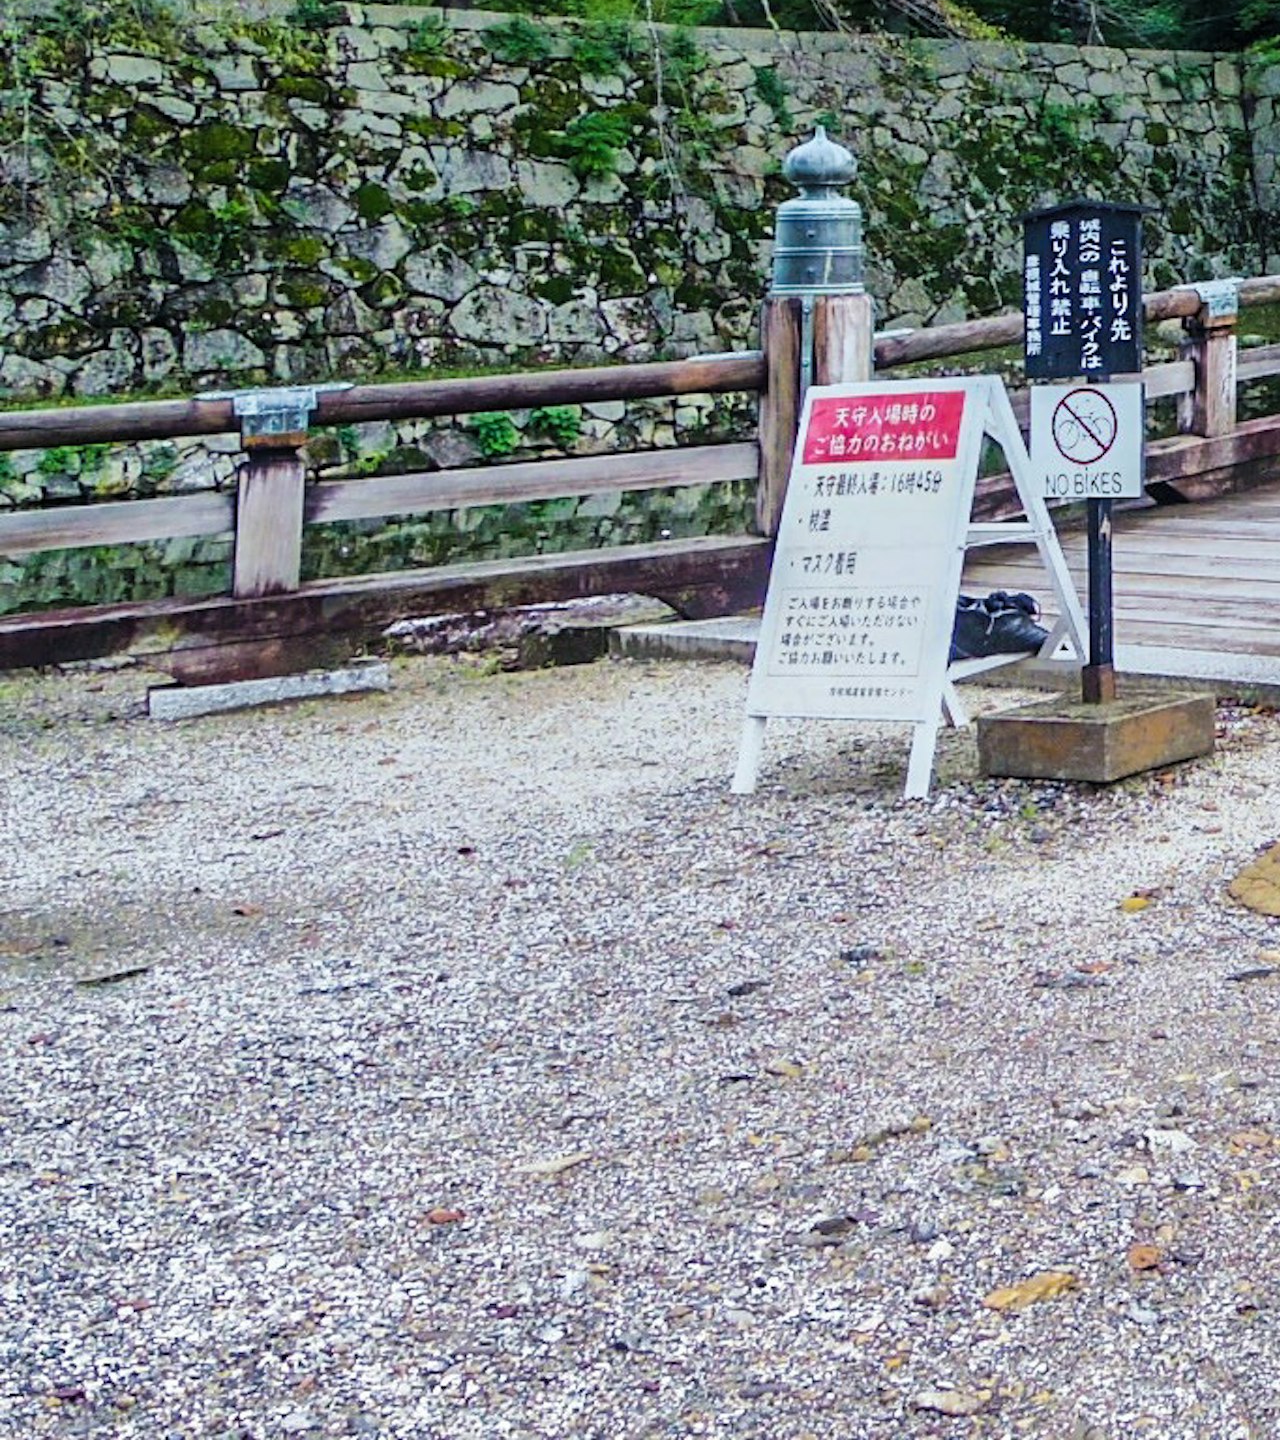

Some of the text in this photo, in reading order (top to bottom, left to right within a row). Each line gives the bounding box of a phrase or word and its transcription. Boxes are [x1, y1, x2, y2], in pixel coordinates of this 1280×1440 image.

[1049, 220, 1072, 335] 乗り入れ禁止
[1107, 239, 1132, 343] これより先
[832, 403, 936, 428] 天守入場時の
[813, 431, 949, 456] ご協力のおねがい
[1045, 473, 1069, 496] NO
[788, 596, 921, 610] ご入場をお断りする場合や
[785, 614, 918, 628] すぐにご入場いただけない
[781, 633, 875, 647] 場合がございます。
[778, 650, 906, 665] ご協力お願いいたします。
